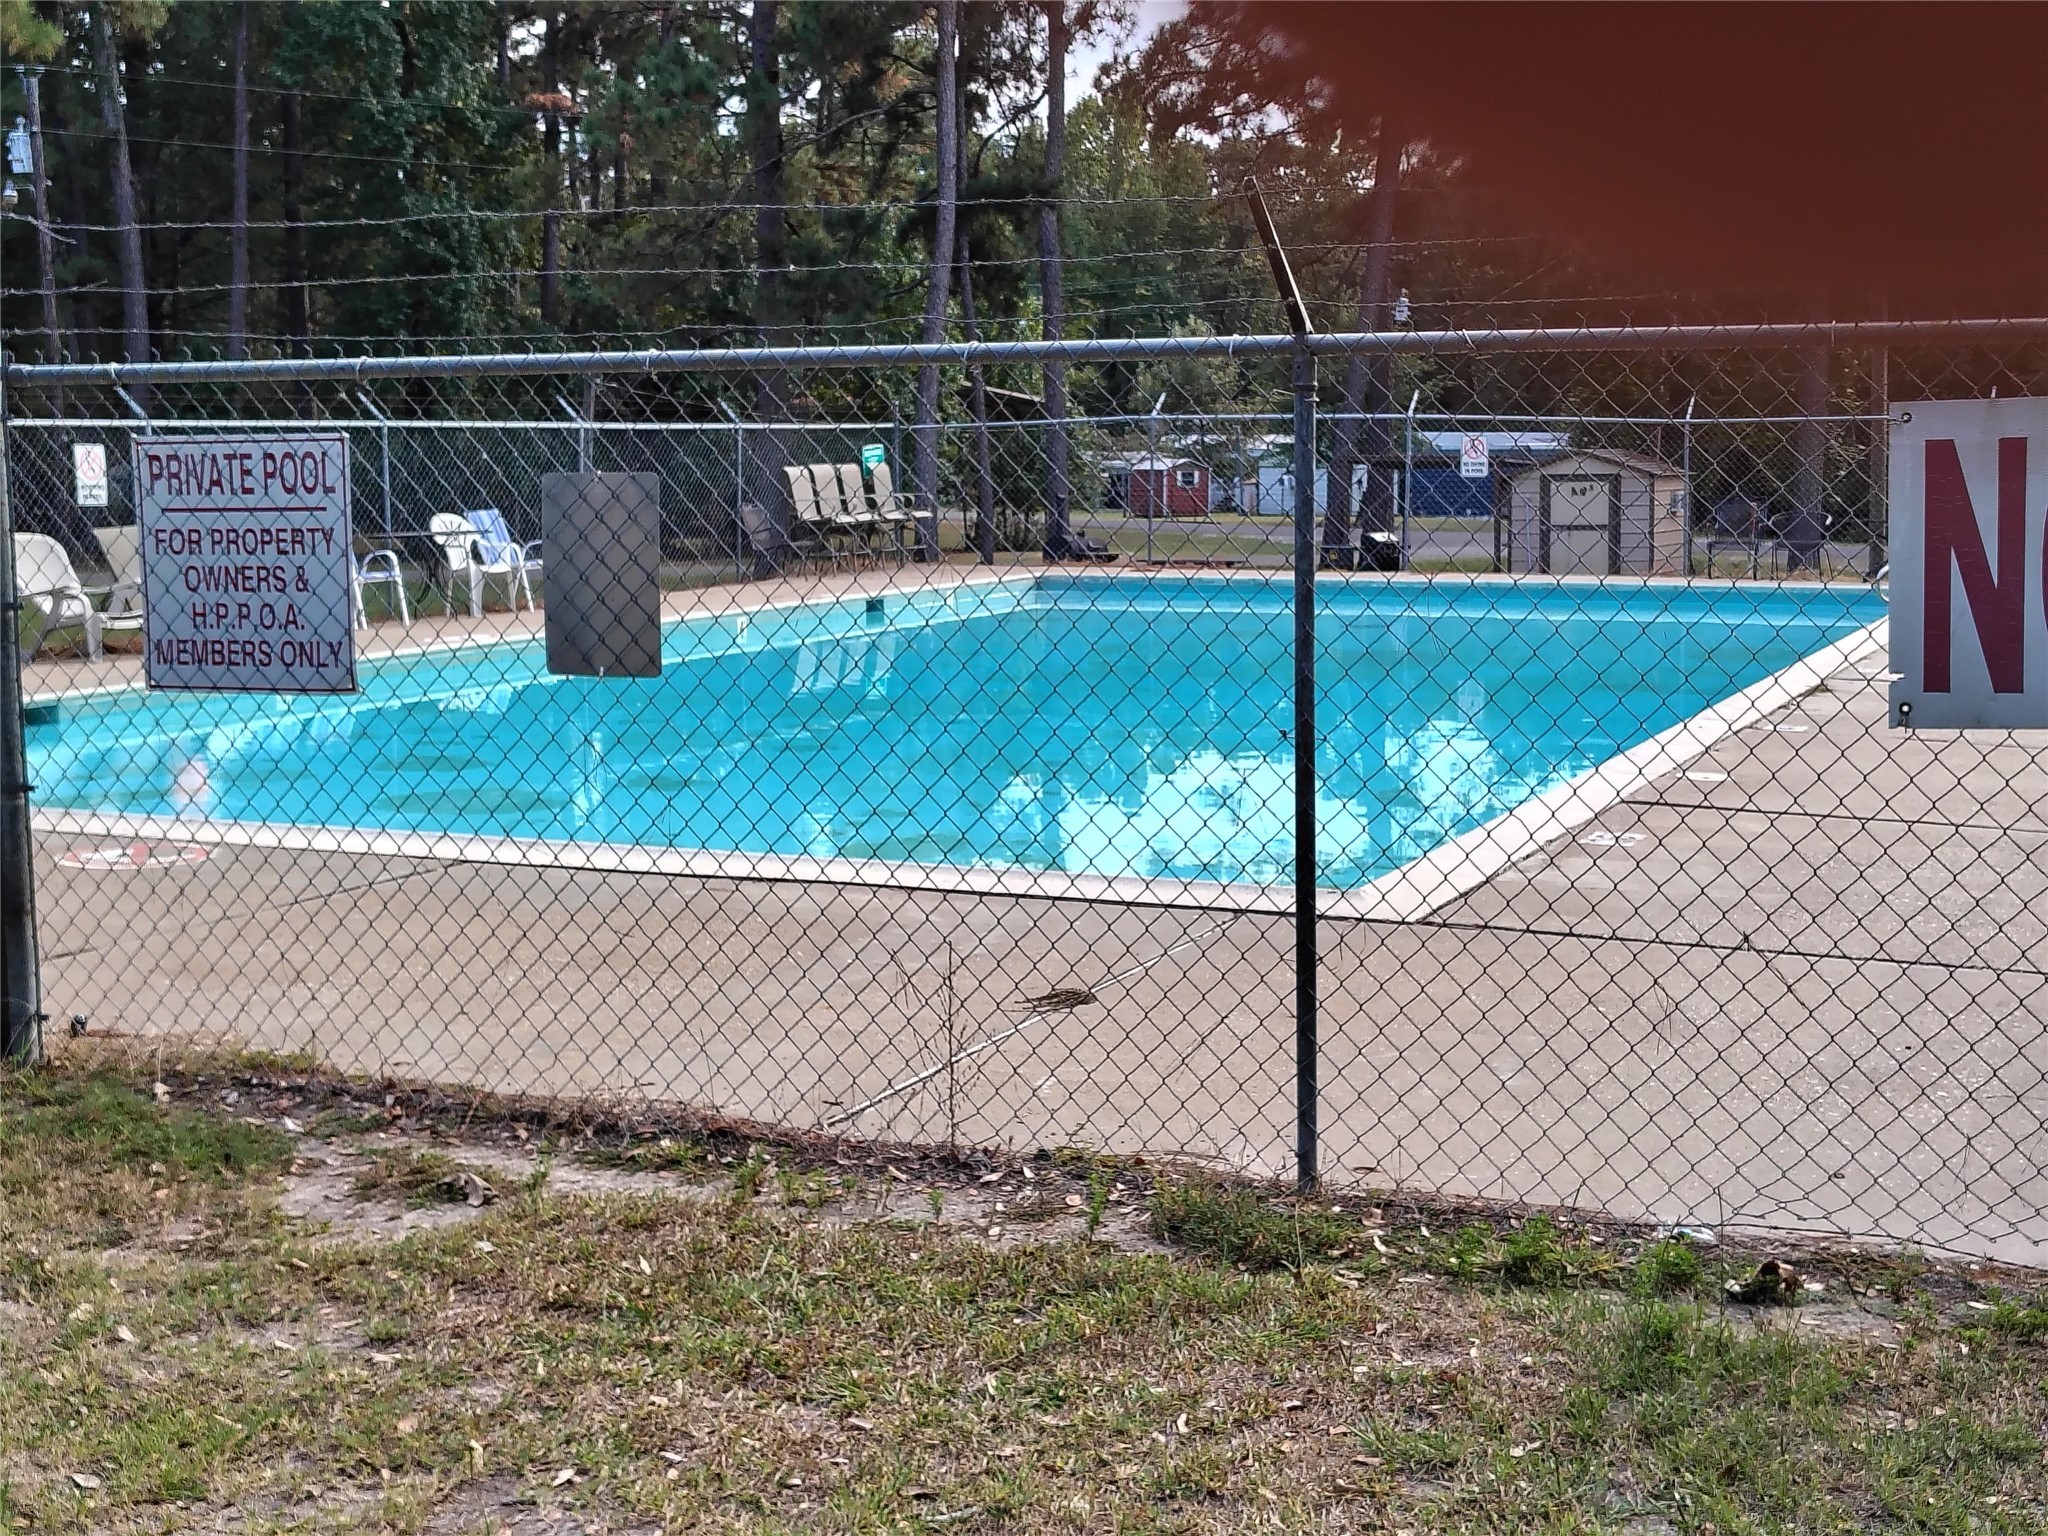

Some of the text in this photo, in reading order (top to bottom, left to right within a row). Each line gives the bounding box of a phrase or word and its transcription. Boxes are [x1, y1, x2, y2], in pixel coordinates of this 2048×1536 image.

[147, 451, 336, 496] PRIVATE POOL
[154, 528, 335, 556] FOR PROPERTY
[184, 565, 310, 593] OWNERS &
[1923, 436, 2048, 693] N
[155, 639, 343, 669] MEMBERS ONLY
